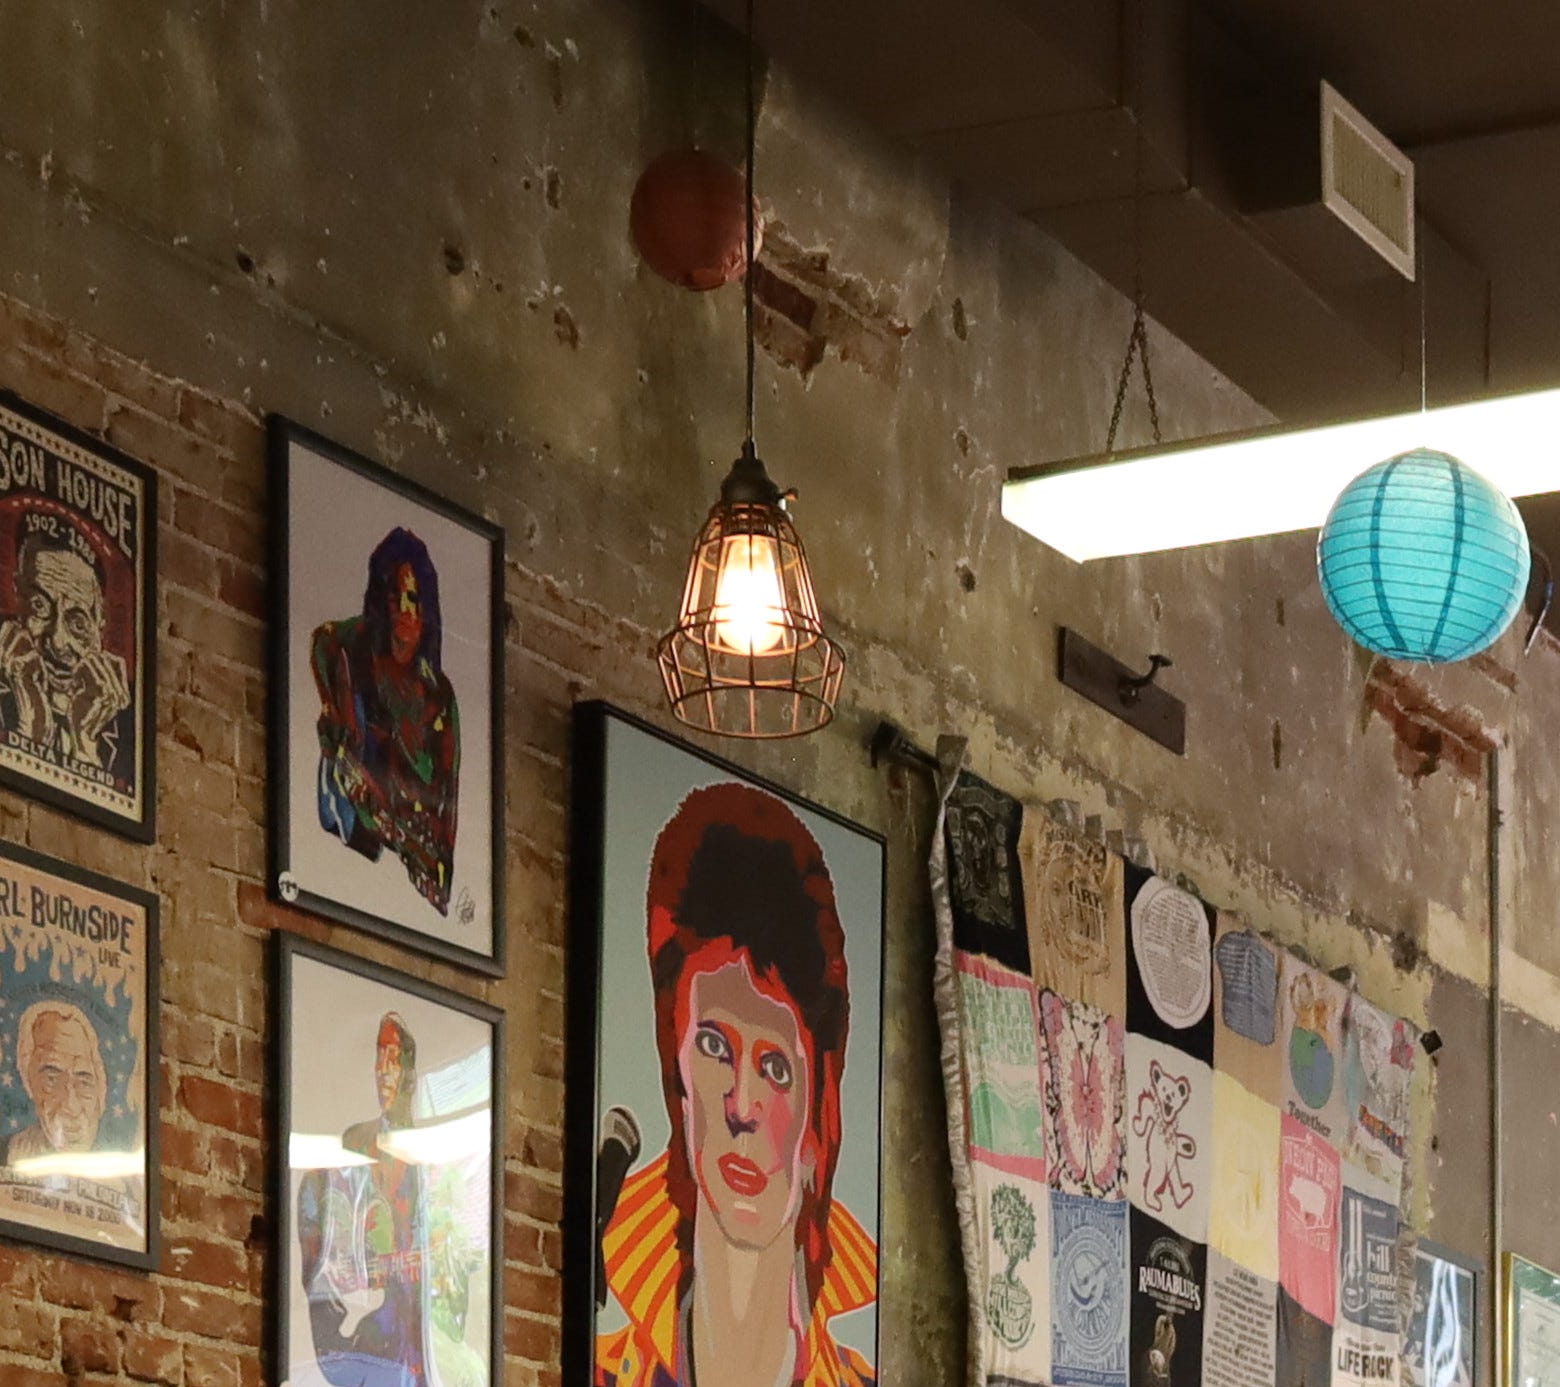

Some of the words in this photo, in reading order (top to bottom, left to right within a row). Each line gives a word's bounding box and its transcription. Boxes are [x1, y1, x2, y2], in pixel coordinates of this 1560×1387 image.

[56, 459, 133, 558] HOUSE
[8, 729, 56, 767] DELTA
[62, 752, 116, 787] LEGEND
[29, 884, 135, 956] BURNSIDE
[96, 944, 122, 970] LIVE
[1288, 1100, 1332, 1139] Together
[1367, 1241, 1390, 1274] hill
[1338, 1345, 1361, 1378] LIFE
[1361, 1351, 1395, 1382] ROCK
